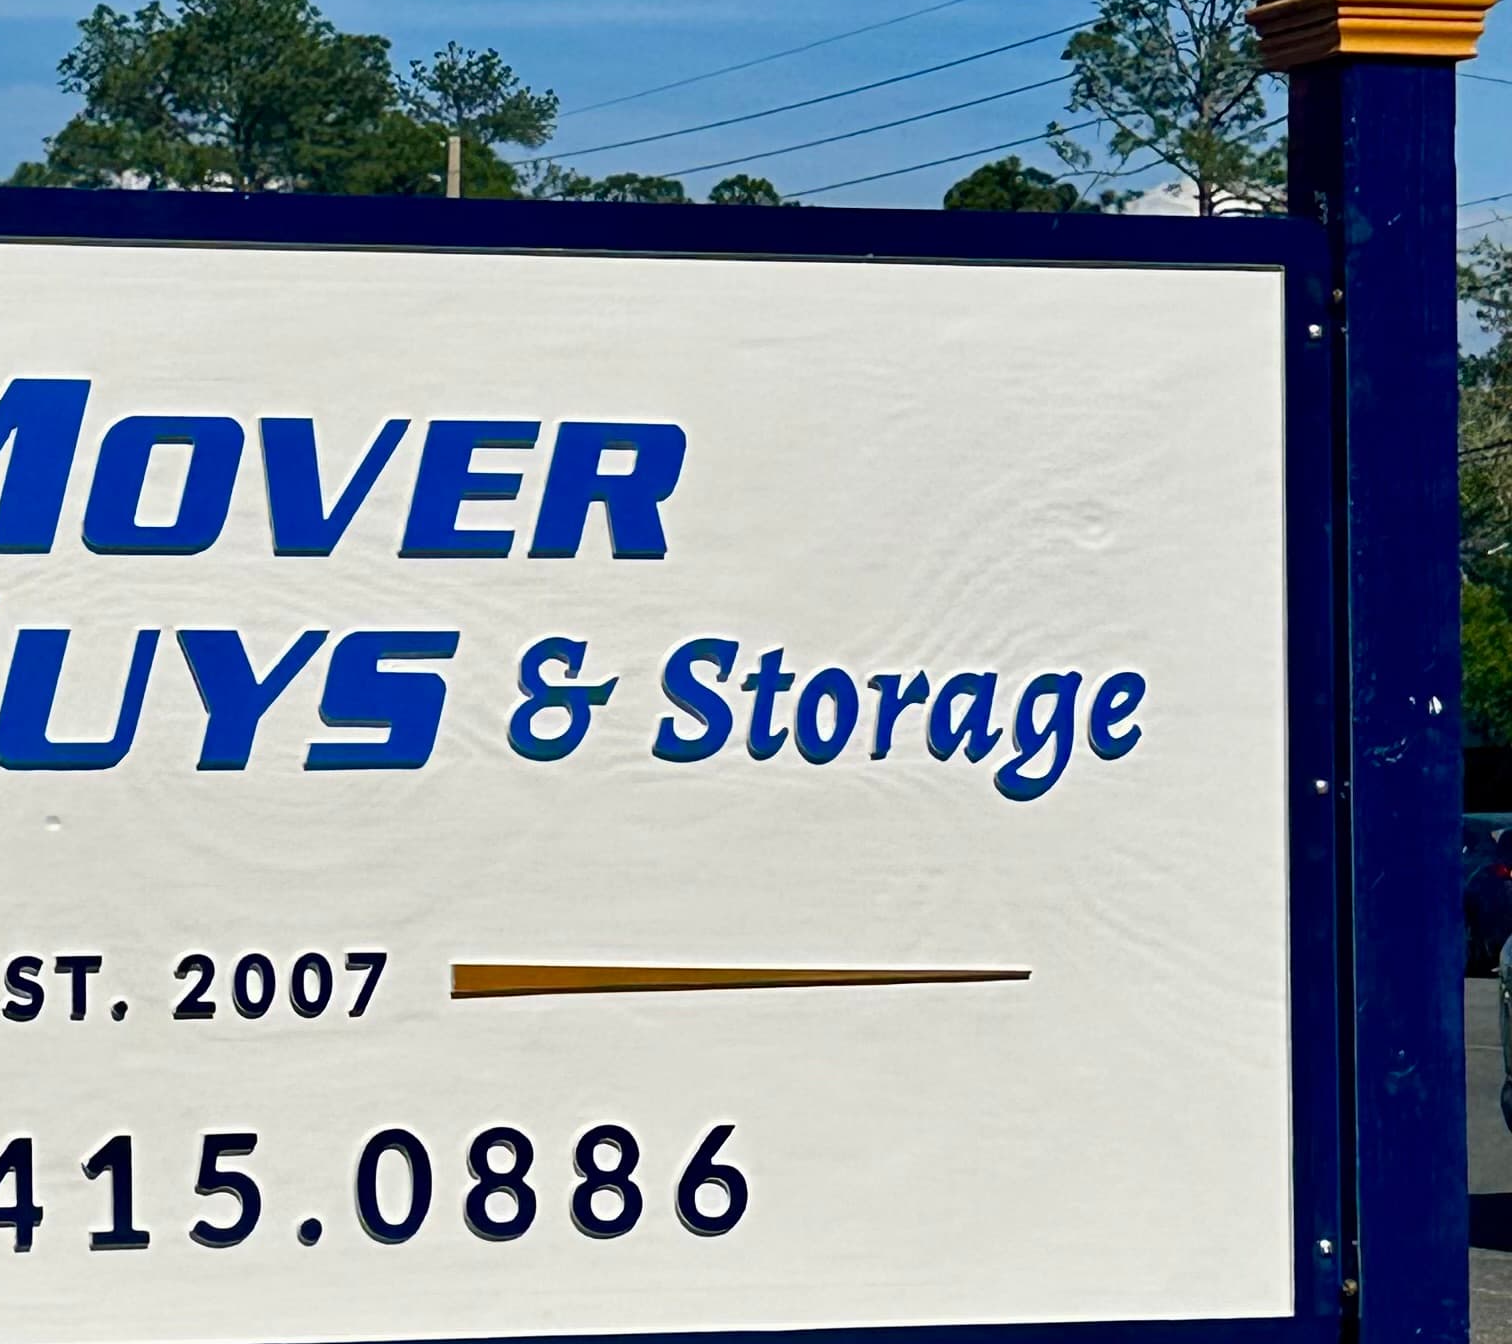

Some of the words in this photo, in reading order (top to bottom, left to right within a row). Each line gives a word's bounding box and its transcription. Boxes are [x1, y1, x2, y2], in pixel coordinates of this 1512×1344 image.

[506, 636, 620, 764] &
[651, 637, 1146, 803] Storage
[172, 951, 388, 1022] 2007
